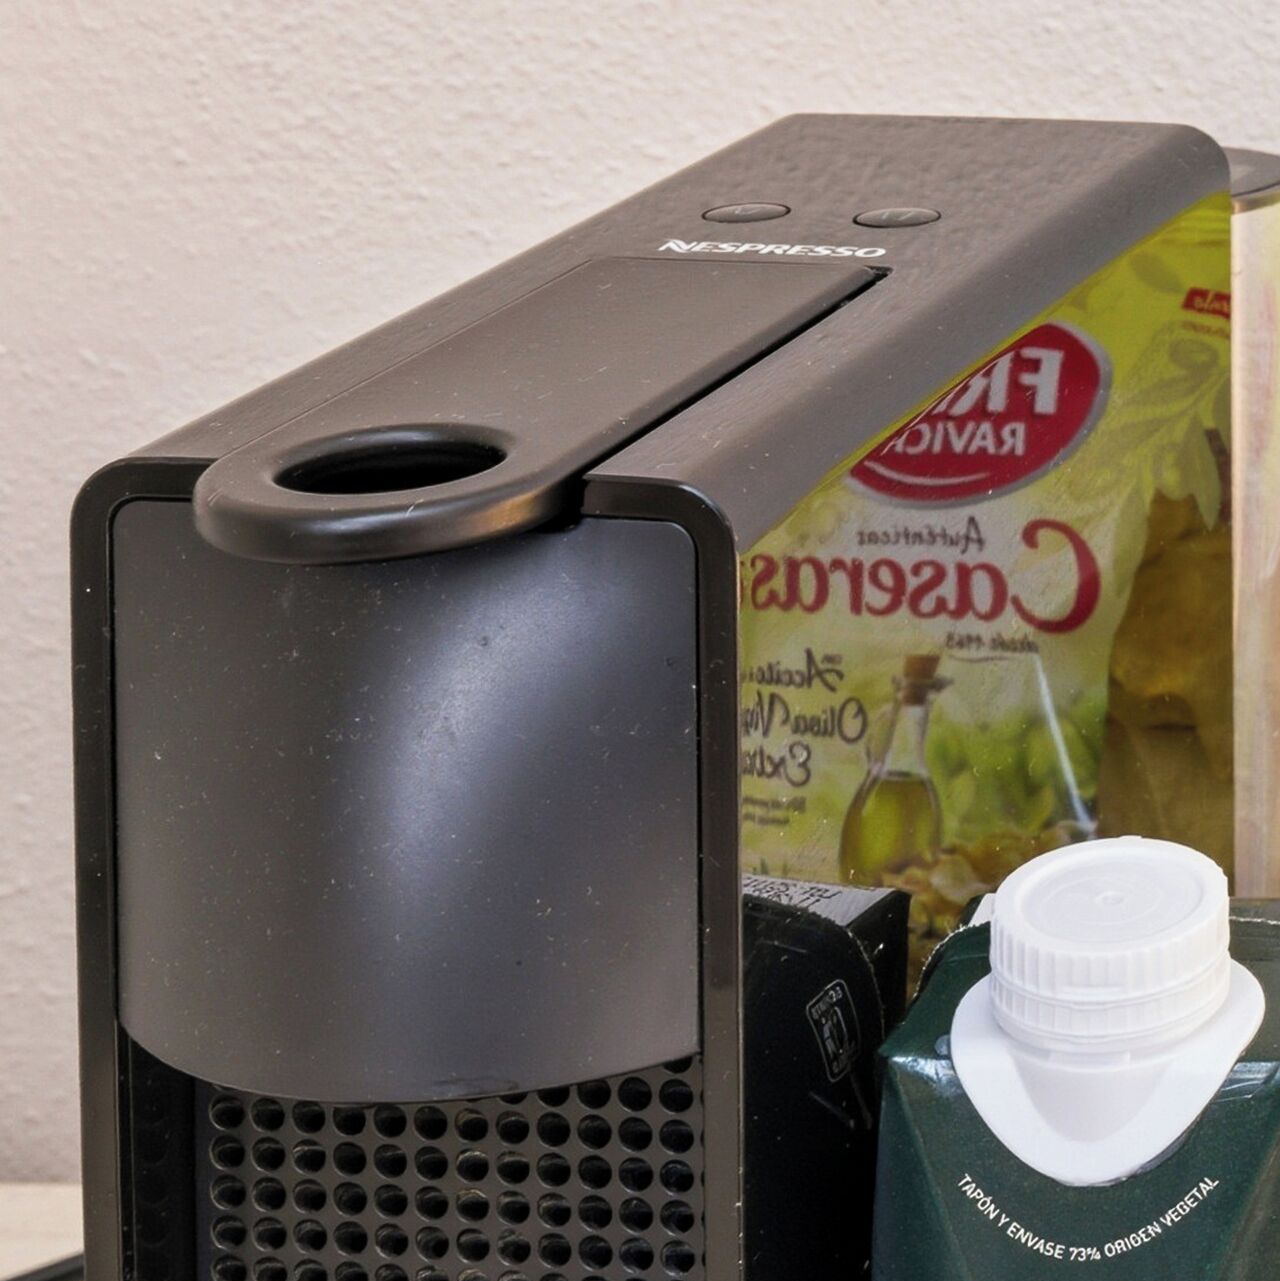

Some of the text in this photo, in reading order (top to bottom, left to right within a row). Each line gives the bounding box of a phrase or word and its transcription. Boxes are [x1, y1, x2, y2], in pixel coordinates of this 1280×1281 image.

[658, 239, 887, 258] NESPRESSO
[958, 1173, 1220, 1262] TAPÓN Y ENVASE 73% ORIGEN VEGETAL
